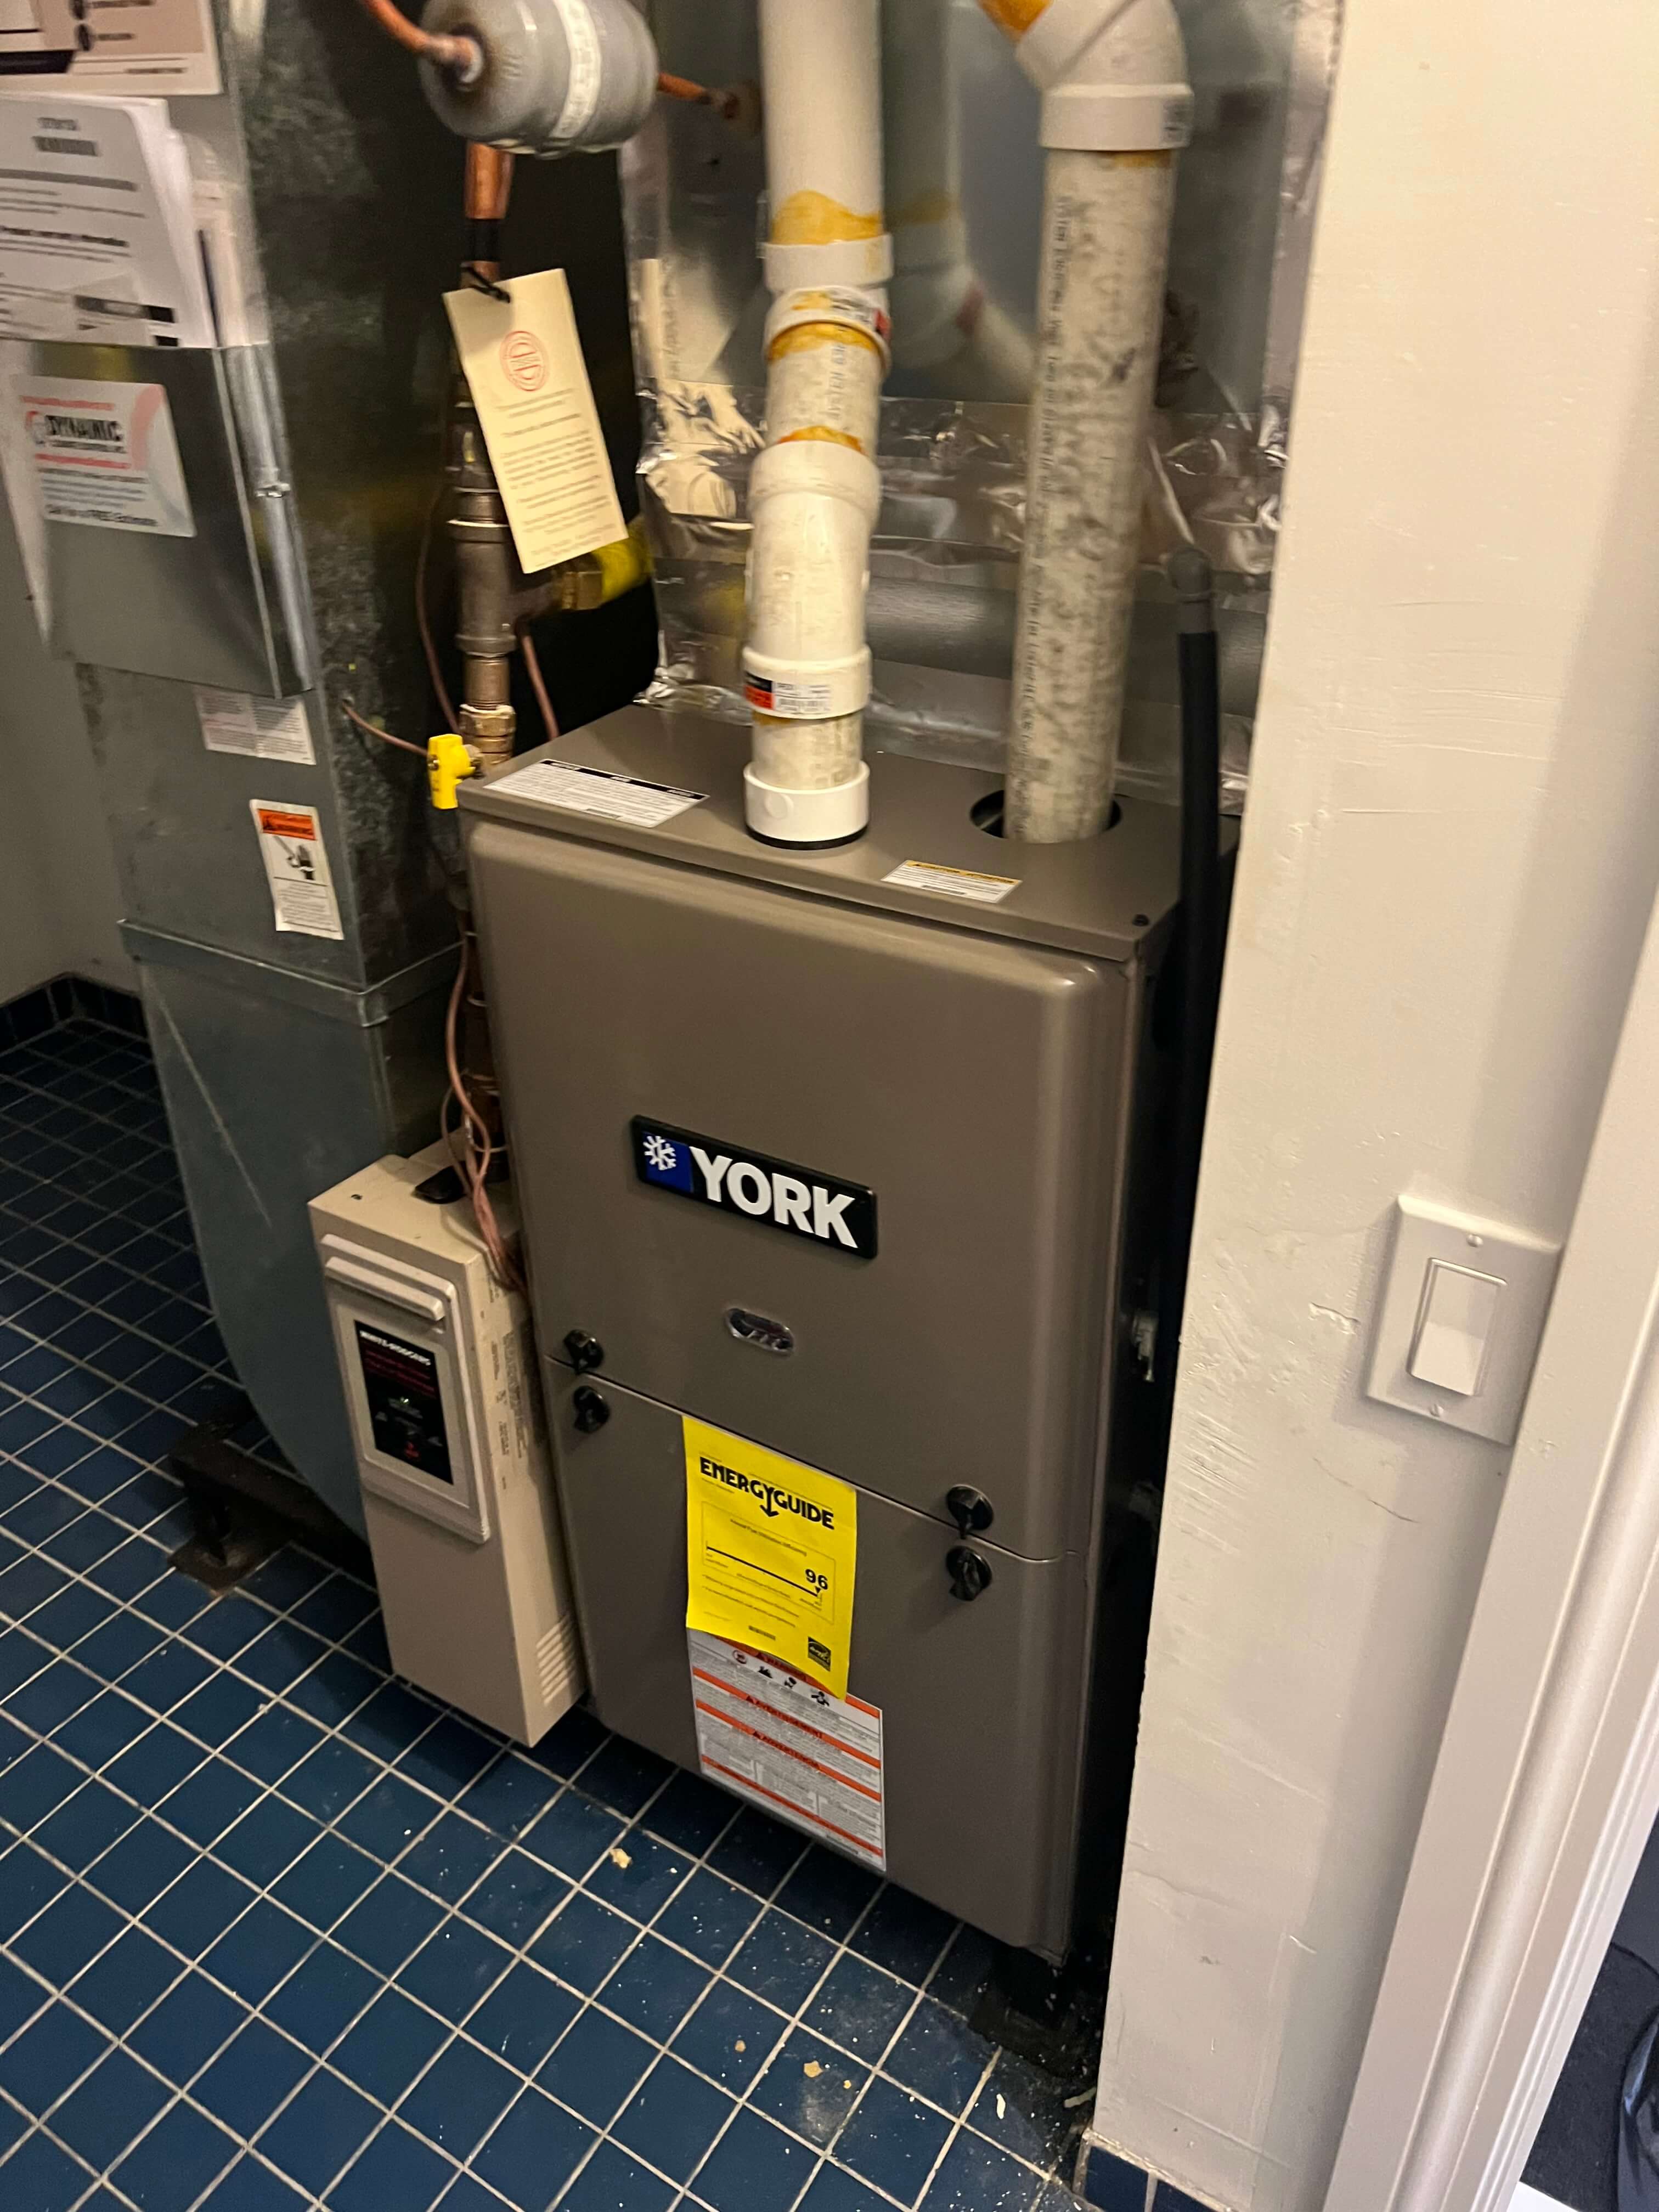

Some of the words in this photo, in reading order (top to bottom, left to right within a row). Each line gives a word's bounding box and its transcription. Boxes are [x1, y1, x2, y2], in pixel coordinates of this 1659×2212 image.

[689, 1146, 858, 1248] YORK
[699, 1457, 834, 1530] ENERGYGUIDE
[805, 1568, 828, 1590] 96
